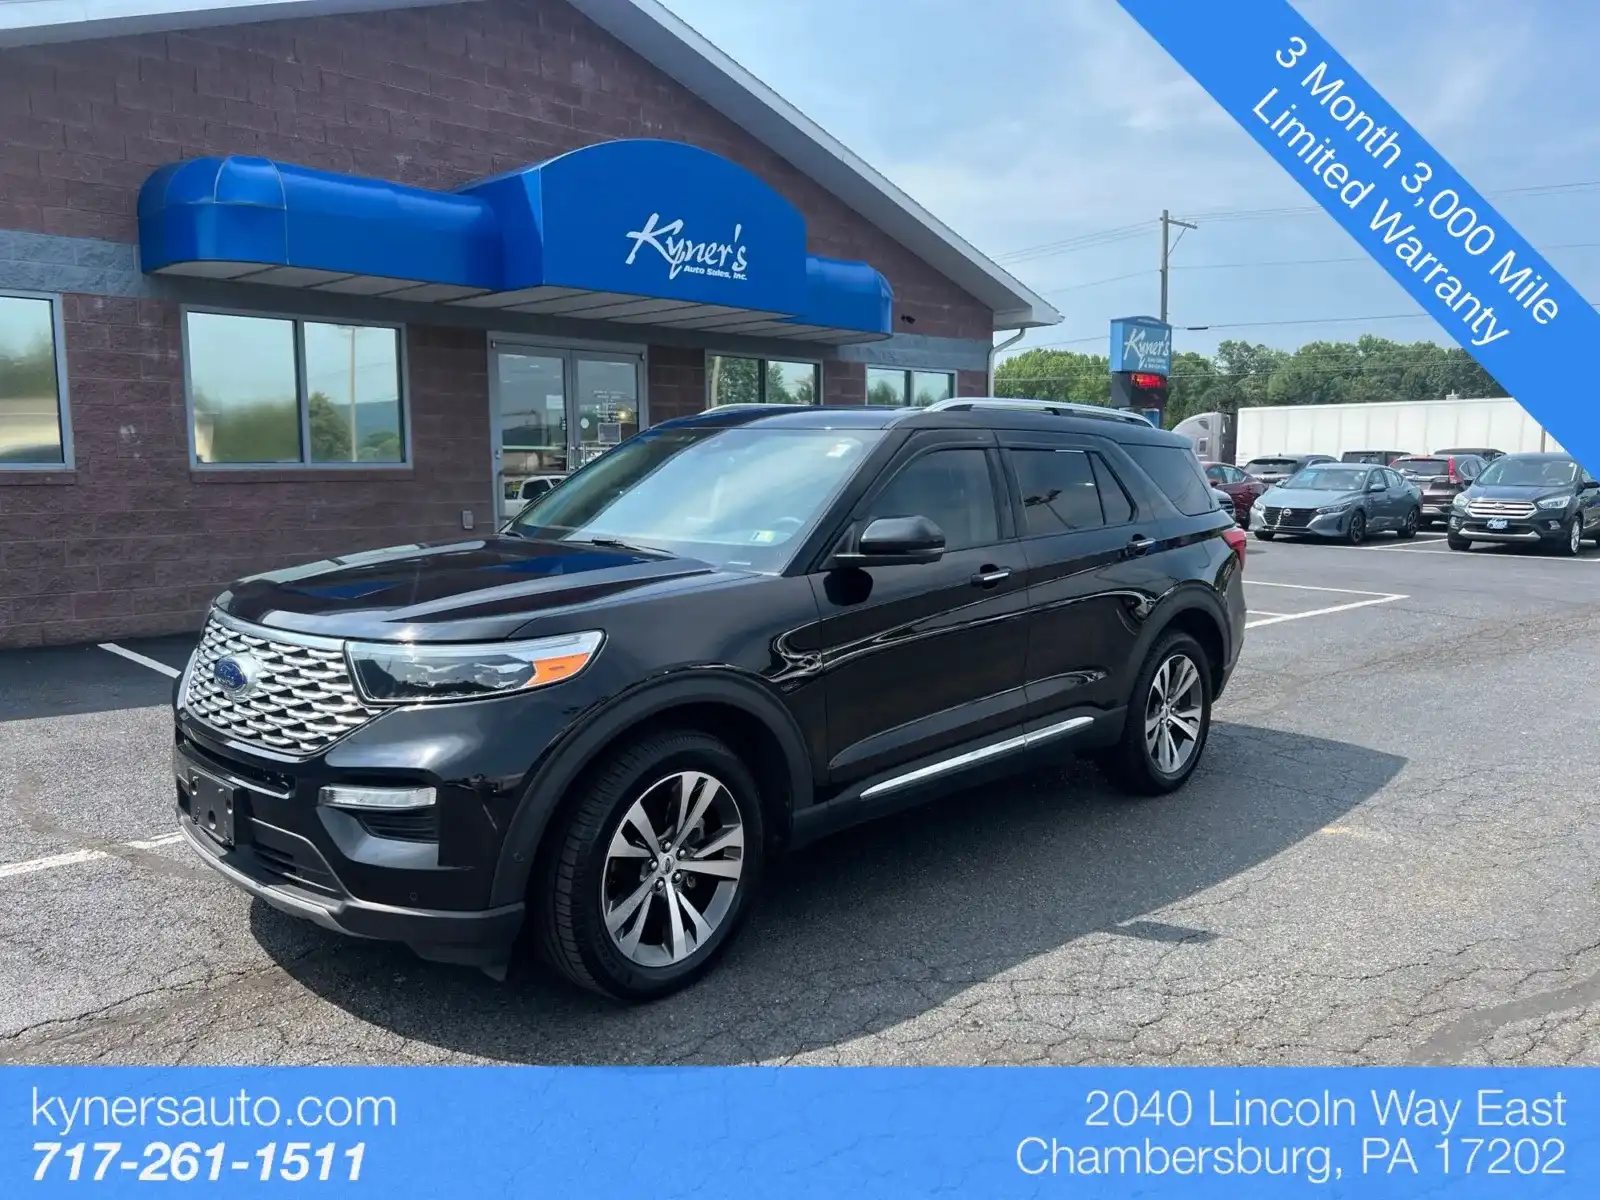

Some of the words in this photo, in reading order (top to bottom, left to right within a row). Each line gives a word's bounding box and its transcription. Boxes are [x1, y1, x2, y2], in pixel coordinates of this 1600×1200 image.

[625, 212, 748, 280] Kyner's
[683, 264, 705, 275] Auto
[706, 268, 731, 279] Sales,
[732, 271, 748, 280] Inc.
[1123, 328, 1170, 370] Kyner's
